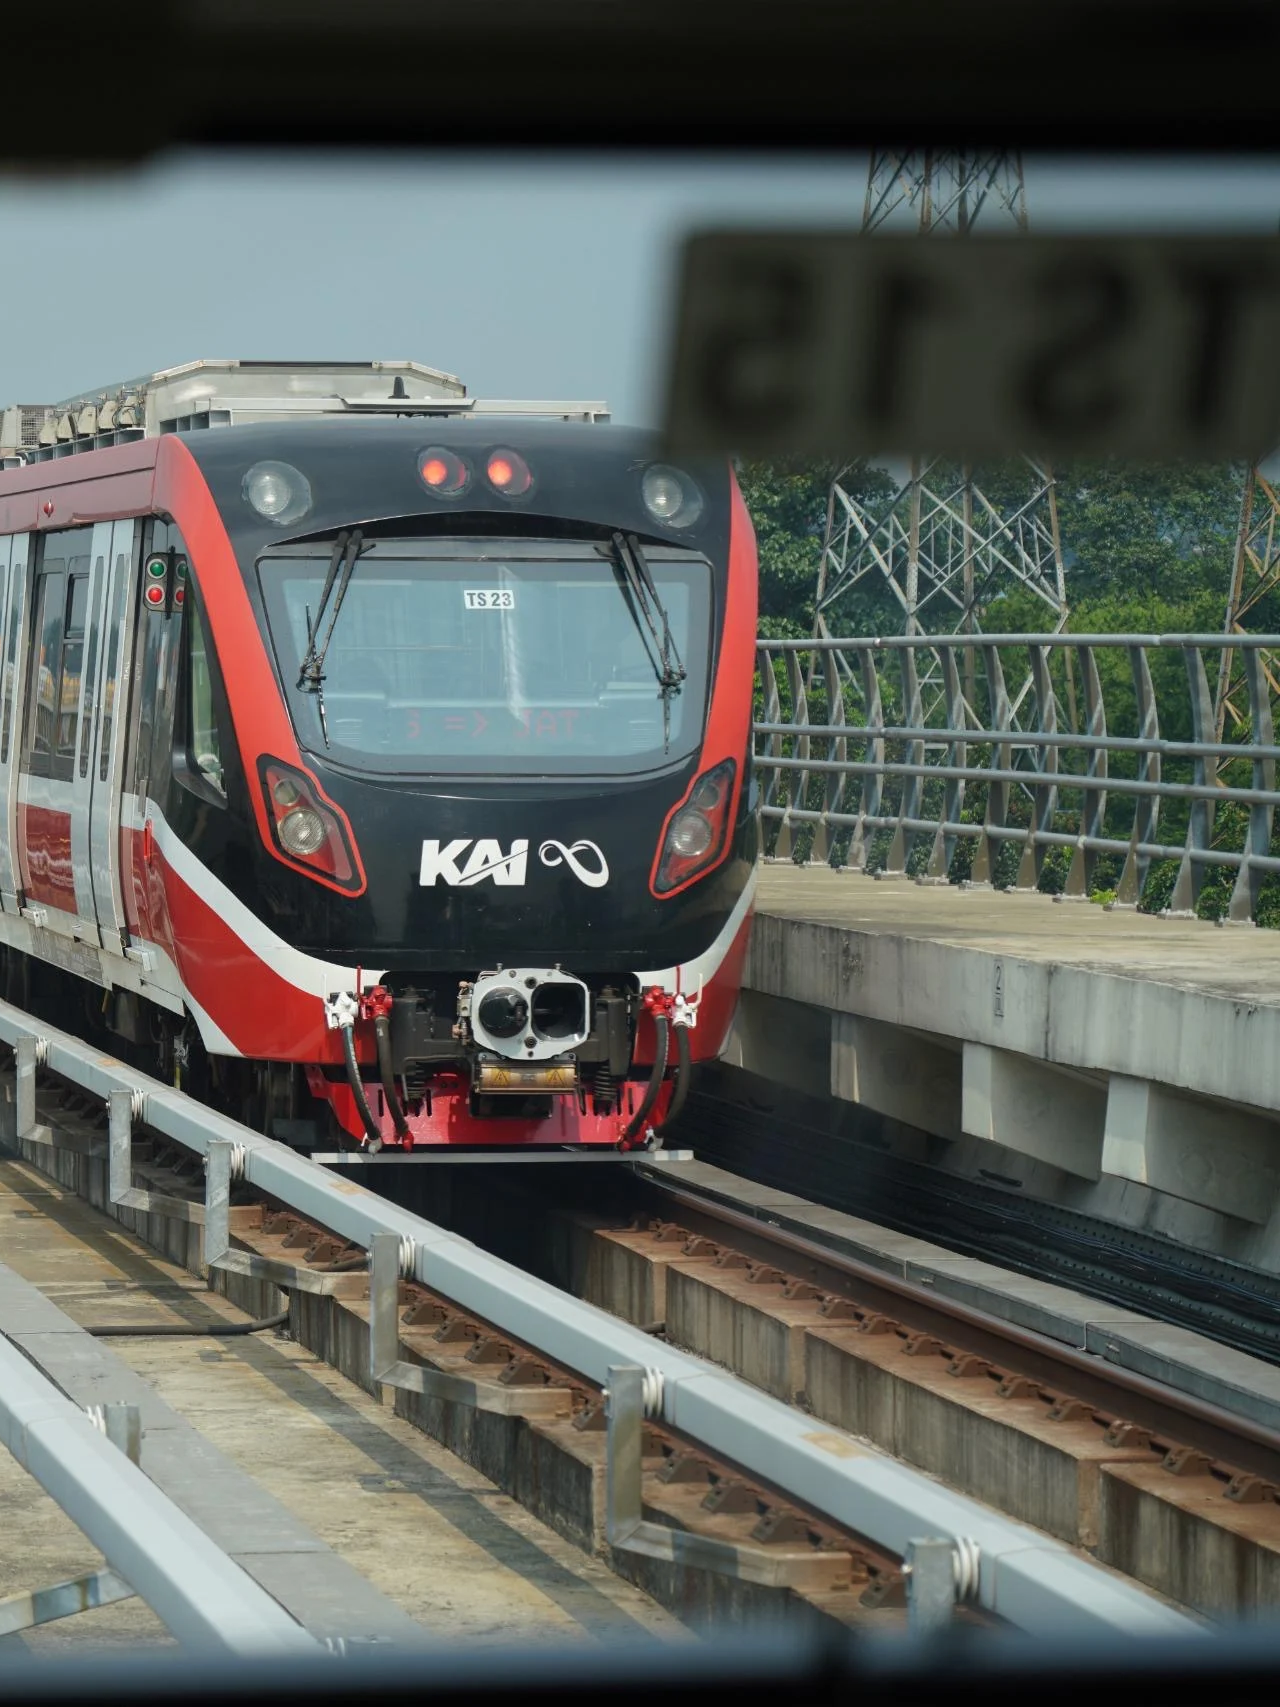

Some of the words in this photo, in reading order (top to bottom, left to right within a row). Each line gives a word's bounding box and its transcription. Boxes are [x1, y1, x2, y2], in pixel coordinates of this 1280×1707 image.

[466, 592, 487, 607] TS
[491, 592, 512, 607] 23
[419, 839, 529, 886] KAI
